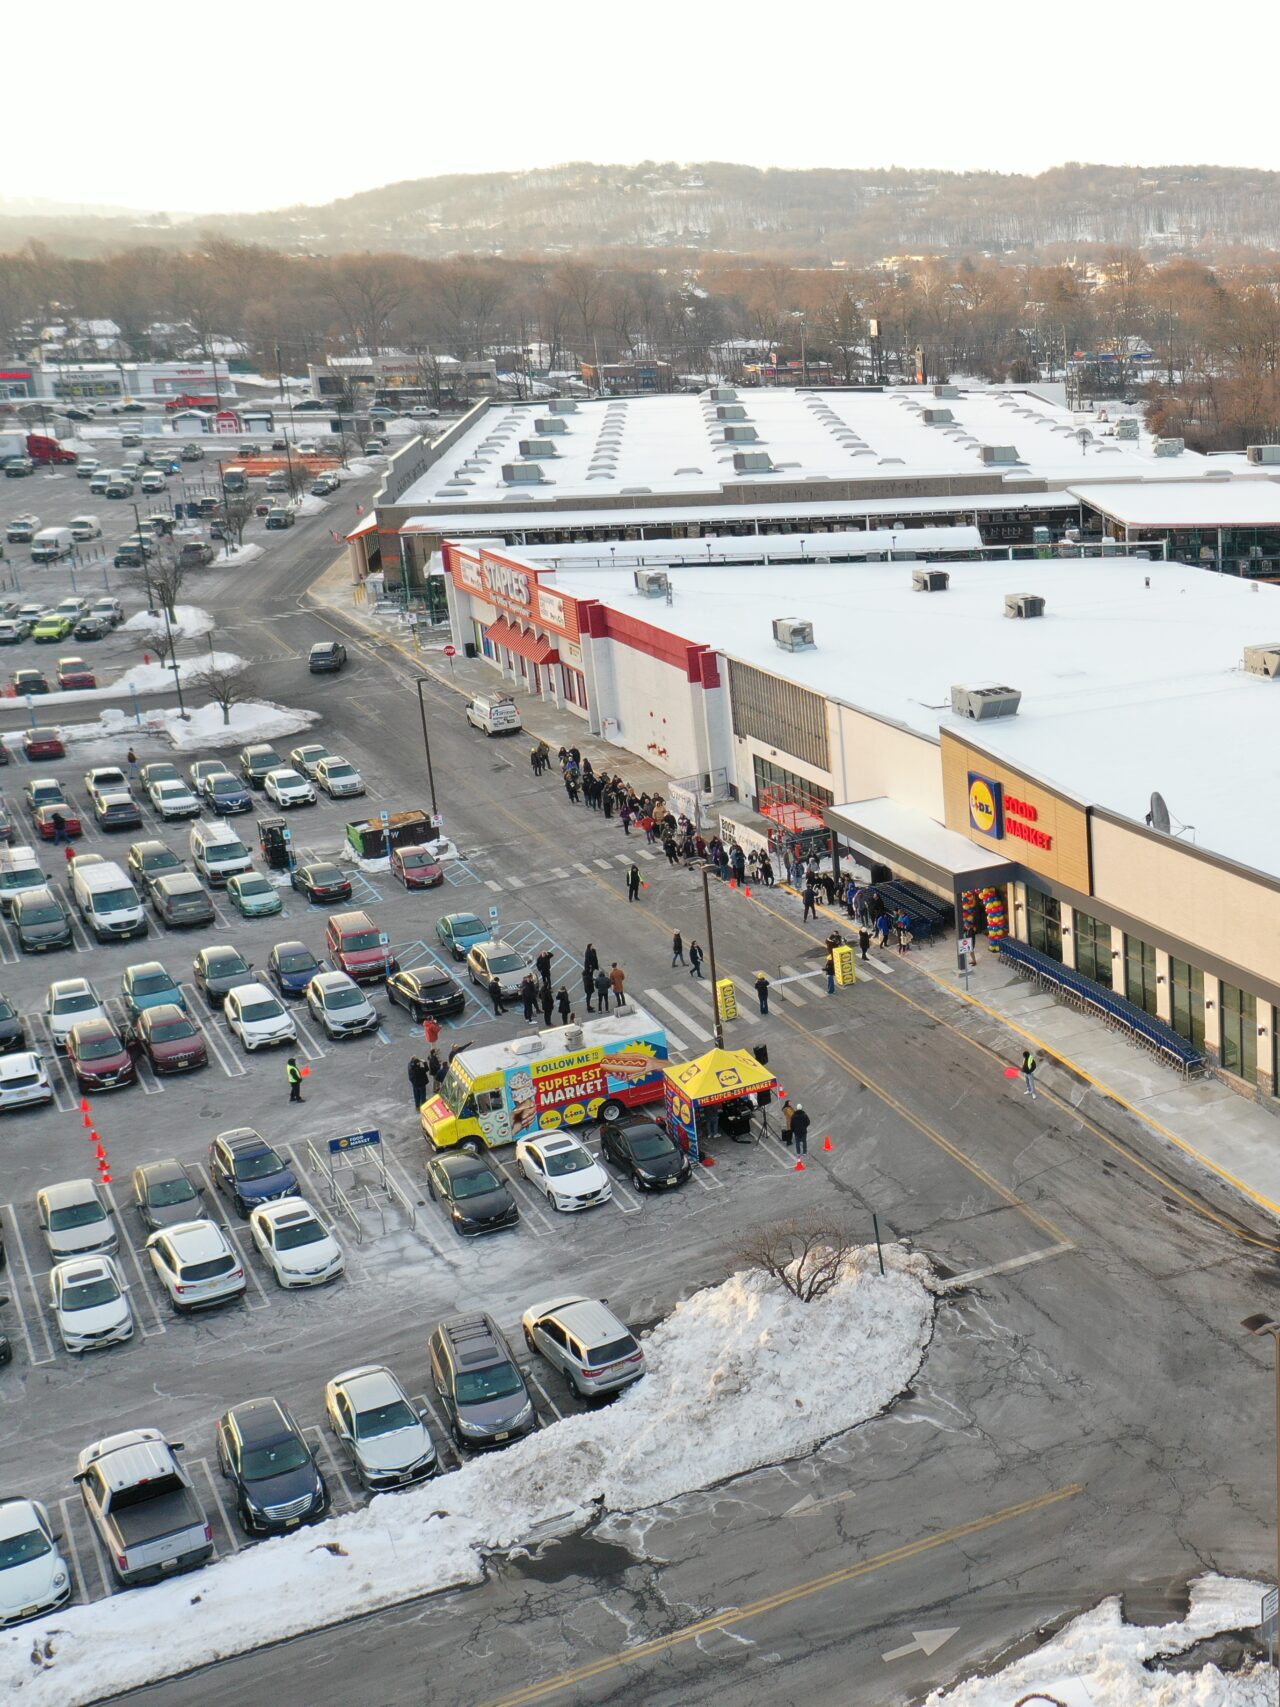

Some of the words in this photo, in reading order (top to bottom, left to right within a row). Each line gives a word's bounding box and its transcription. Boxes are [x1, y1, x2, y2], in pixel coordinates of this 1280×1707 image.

[483, 559, 530, 605] STAPLES
[1004, 794, 1038, 822] FOOD
[1006, 818, 1053, 850] MARKET
[536, 1058, 574, 1074] FOLLOW
[577, 1054, 590, 1064] ME
[538, 1068, 602, 1092] SUPER-EST
[540, 1079, 603, 1106] MARKET
[710, 1088, 744, 1102] SUPER-EST
[746, 1082, 772, 1092] MARKET
